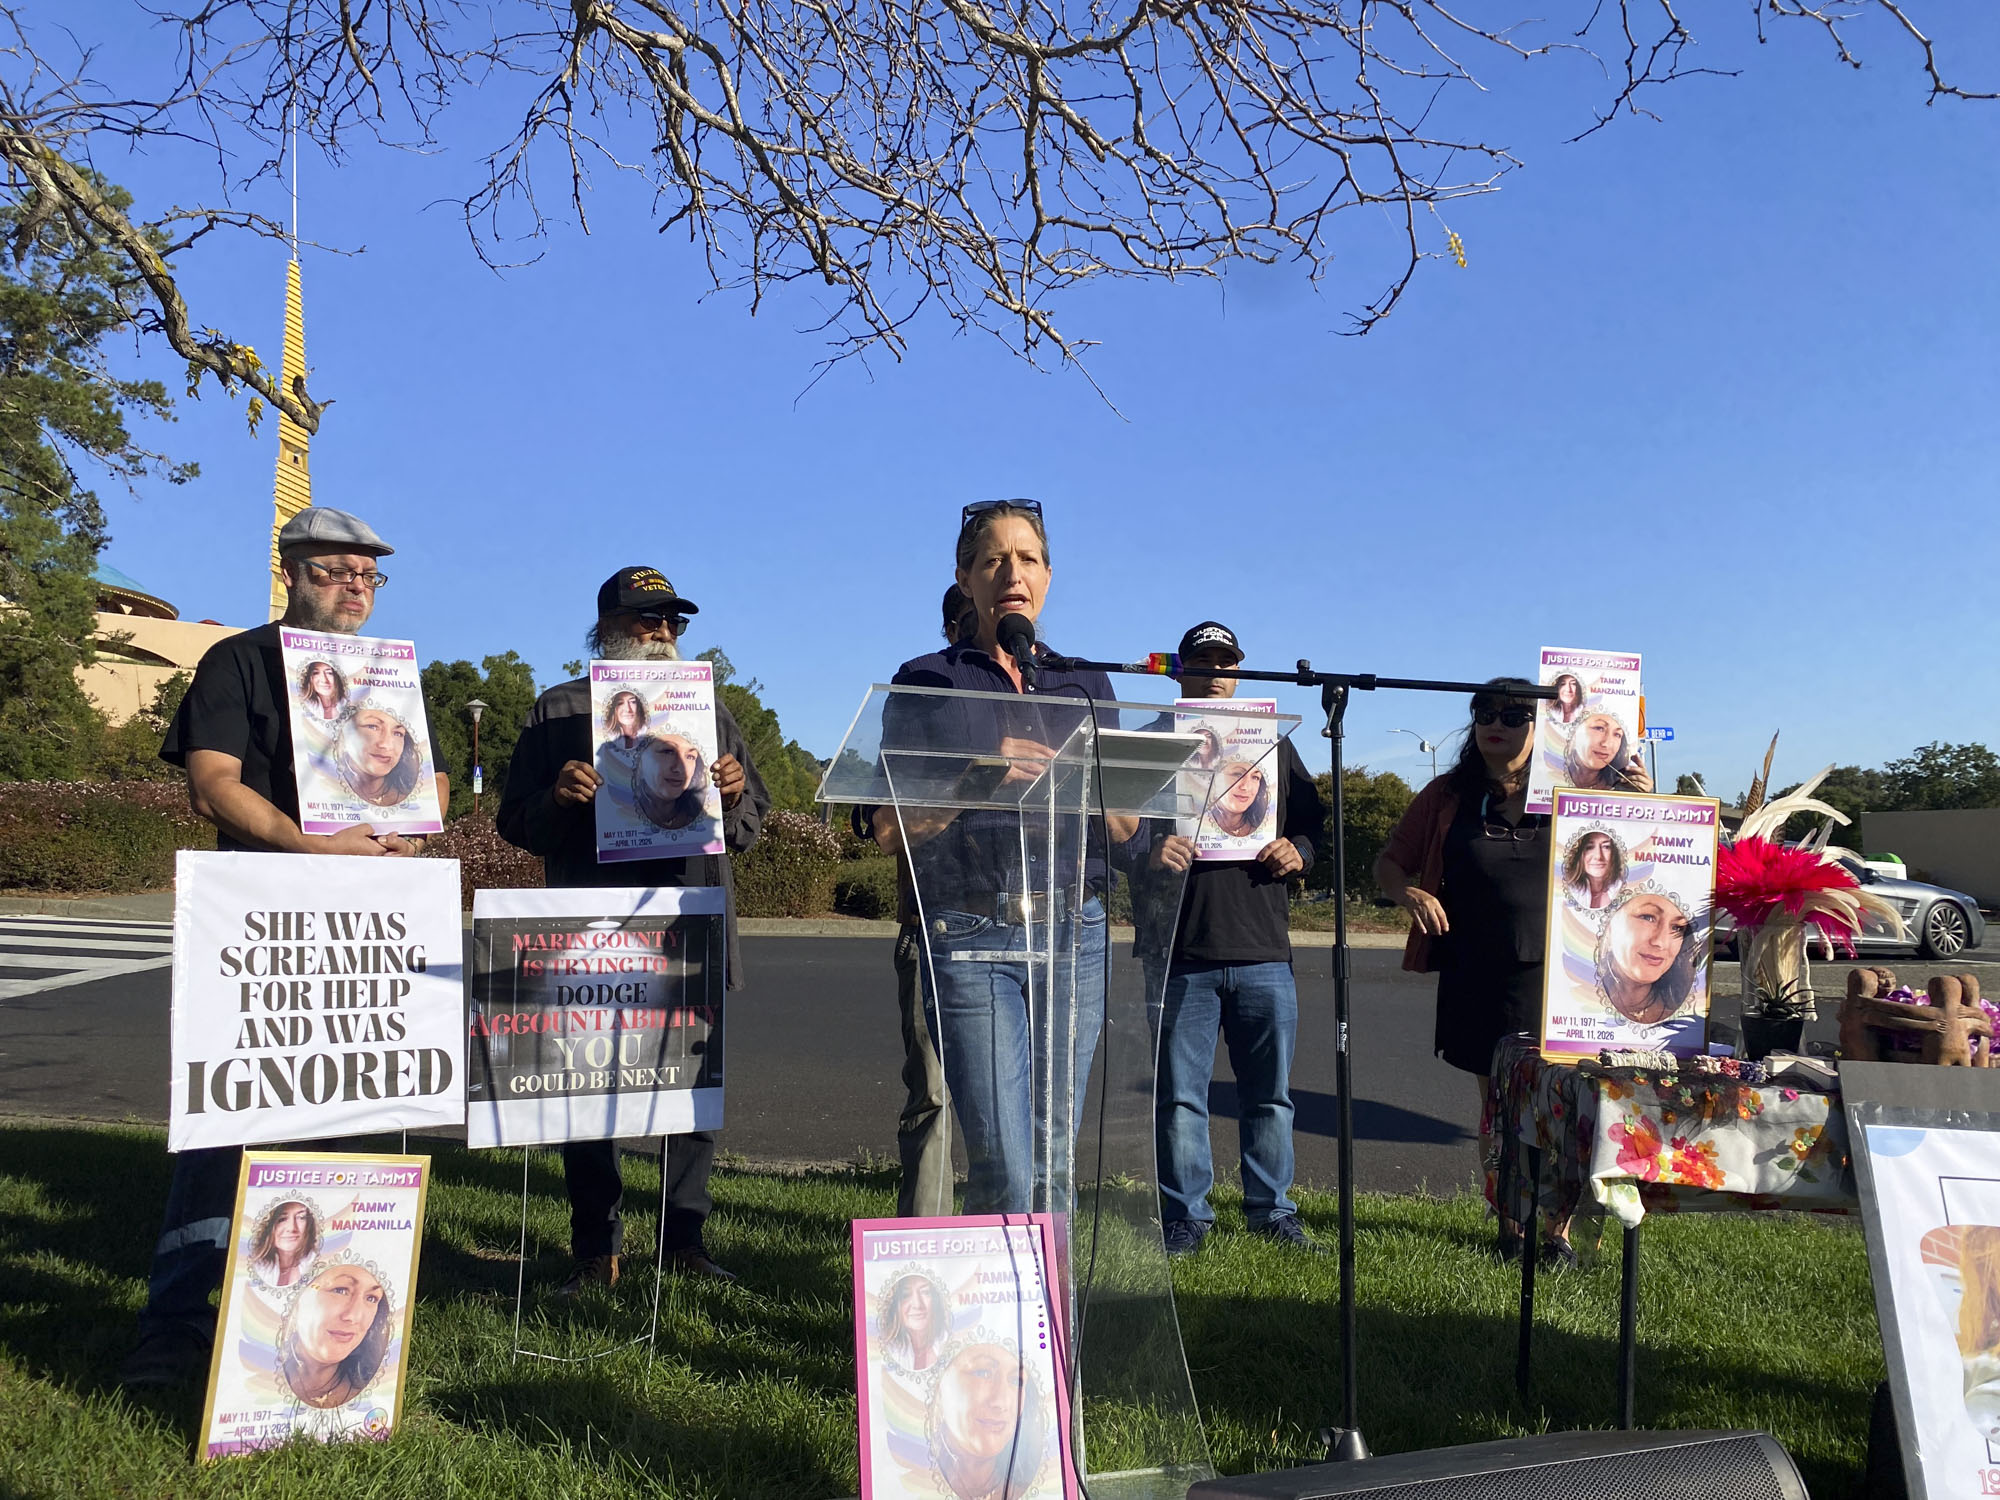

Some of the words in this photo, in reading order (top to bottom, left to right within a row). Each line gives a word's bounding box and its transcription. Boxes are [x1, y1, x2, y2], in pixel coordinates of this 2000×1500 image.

[290, 637, 337, 652] JUSTICE
[340, 644, 364, 655] FOR
[369, 647, 410, 658] TAMMY
[1547, 654, 1582, 666] JUSTICE
[1585, 658, 1602, 666] FOR
[1605, 660, 1637, 669] TAMMY
[364, 666, 399, 677] TAMMY
[598, 669, 641, 681] JUSTICE
[645, 670, 666, 680] FOR
[670, 670, 708, 680] TAMMY
[353, 678, 416, 689] MANZANILLA
[1600, 677, 1626, 685] TAMMY
[665, 691, 696, 699] TAMMY
[1590, 687, 1636, 696] MANZANILLA
[654, 703, 711, 712] MANZANILLA
[1563, 801, 1622, 818] JUSTICE
[1626, 805, 1656, 820] FOR
[1660, 809, 1713, 824] TAMMY
[1650, 836, 1694, 849] TAMMY
[1634, 851, 1711, 866] MANZANILLA
[244, 911, 315, 942] SHE
[324, 912, 407, 941] WAS
[512, 931, 588, 952] MARIN
[592, 930, 680, 948] COUNTY
[220, 944, 427, 977] SCREAMING
[523, 958, 544, 977] IS
[549, 956, 634, 976] TRYING
[638, 956, 668, 974] TO
[239, 980, 313, 1013] FOR
[323, 979, 411, 1010] HELP
[556, 982, 648, 1007] DODGE
[470, 1004, 720, 1037] ACCOUNTABILITY
[1552, 1016, 1568, 1025] MAY
[1570, 1017, 1578, 1027] 11,
[235, 1016, 313, 1049] AND
[323, 1012, 406, 1044] WAS
[1587, 1030, 1595, 1040] 11,
[1597, 1031, 1615, 1040] 2026
[553, 1034, 644, 1070] YOU
[185, 1048, 453, 1115] IGNORED
[510, 1072, 586, 1093] COULD
[589, 1071, 616, 1089] BE
[620, 1066, 680, 1086] NEXT
[256, 1169, 321, 1187] JUSTICE
[325, 1170, 357, 1185] FOR
[362, 1171, 418, 1186] TAMMY
[350, 1202, 396, 1213] TAMMY
[331, 1219, 412, 1231] MANZANILLA
[873, 1239, 937, 1260] JUSTICE
[943, 1239, 975, 1254] FOR
[980, 1235, 1039, 1253] TAMMY
[219, 1413, 238, 1424] MAY
